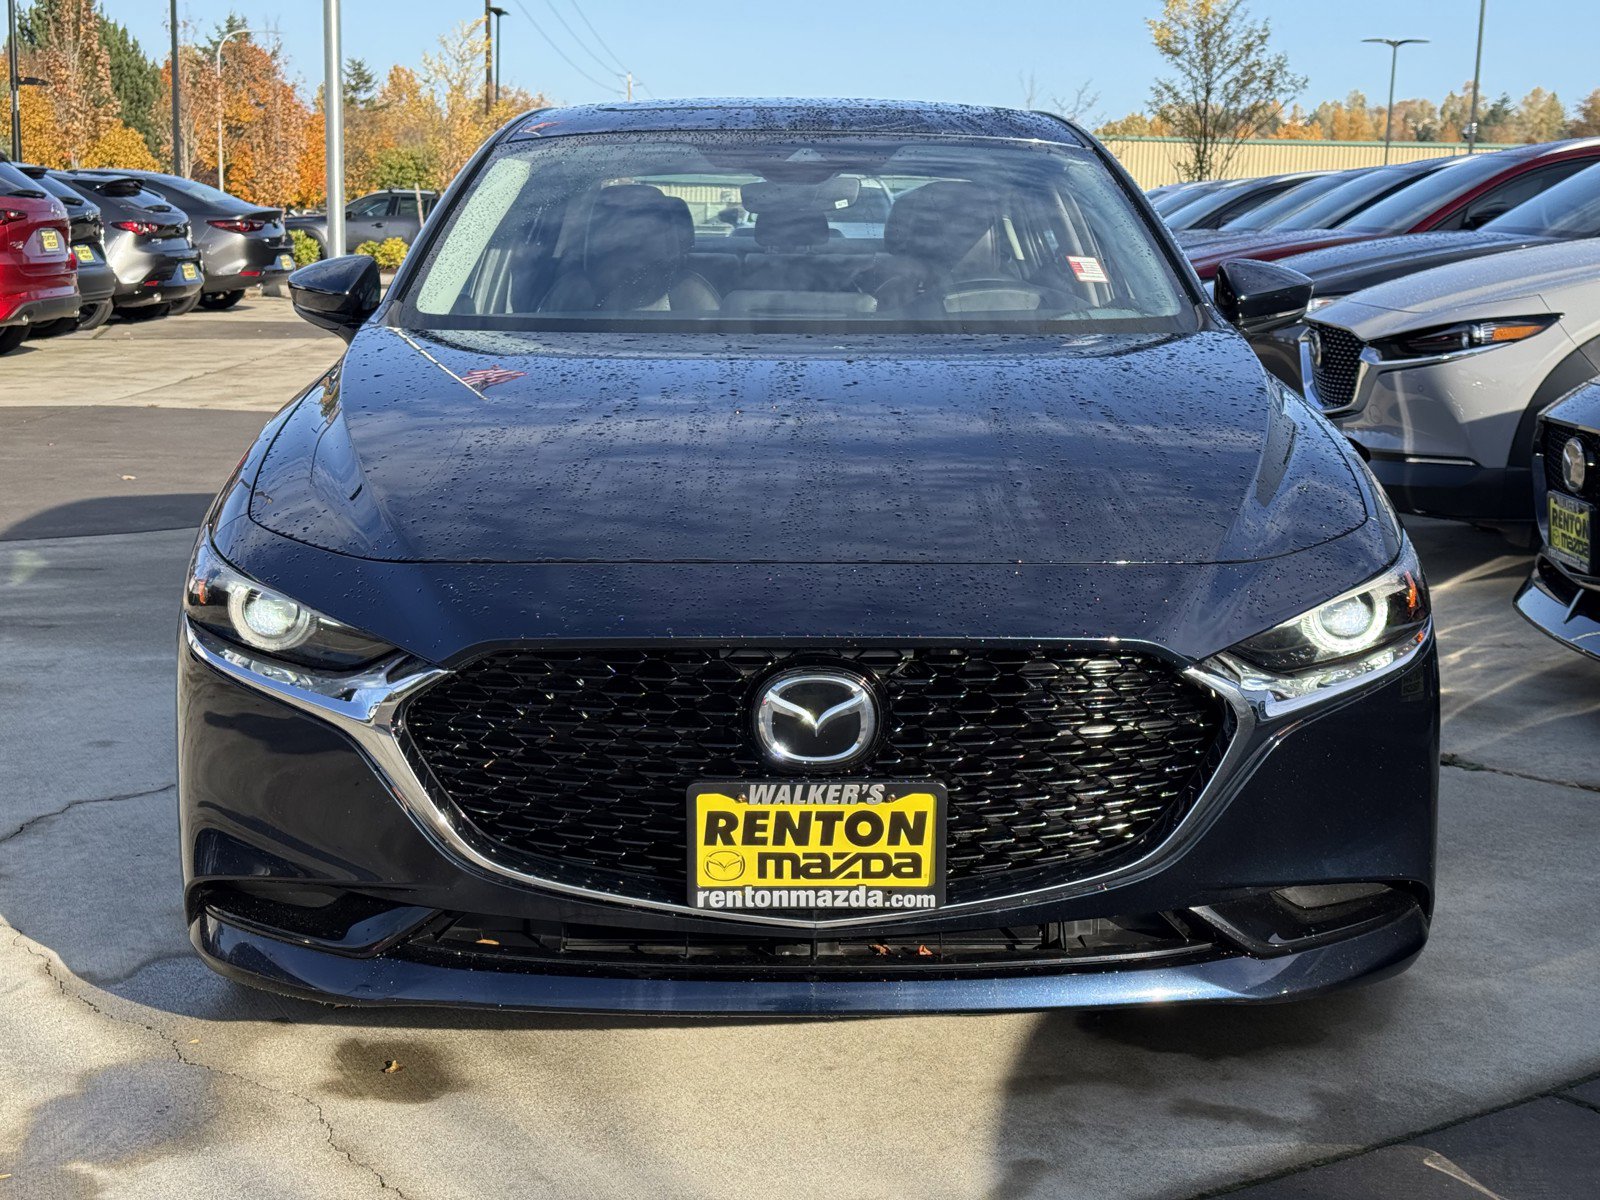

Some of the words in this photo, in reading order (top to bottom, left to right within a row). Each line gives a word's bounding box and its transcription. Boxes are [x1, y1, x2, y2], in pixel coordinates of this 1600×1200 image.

[1552, 507, 1589, 540] RENTON
[749, 784, 885, 805] WALKER'S
[704, 810, 928, 847] RENTON
[757, 852, 923, 879] mazda
[697, 886, 936, 908] rentonmazda.com
